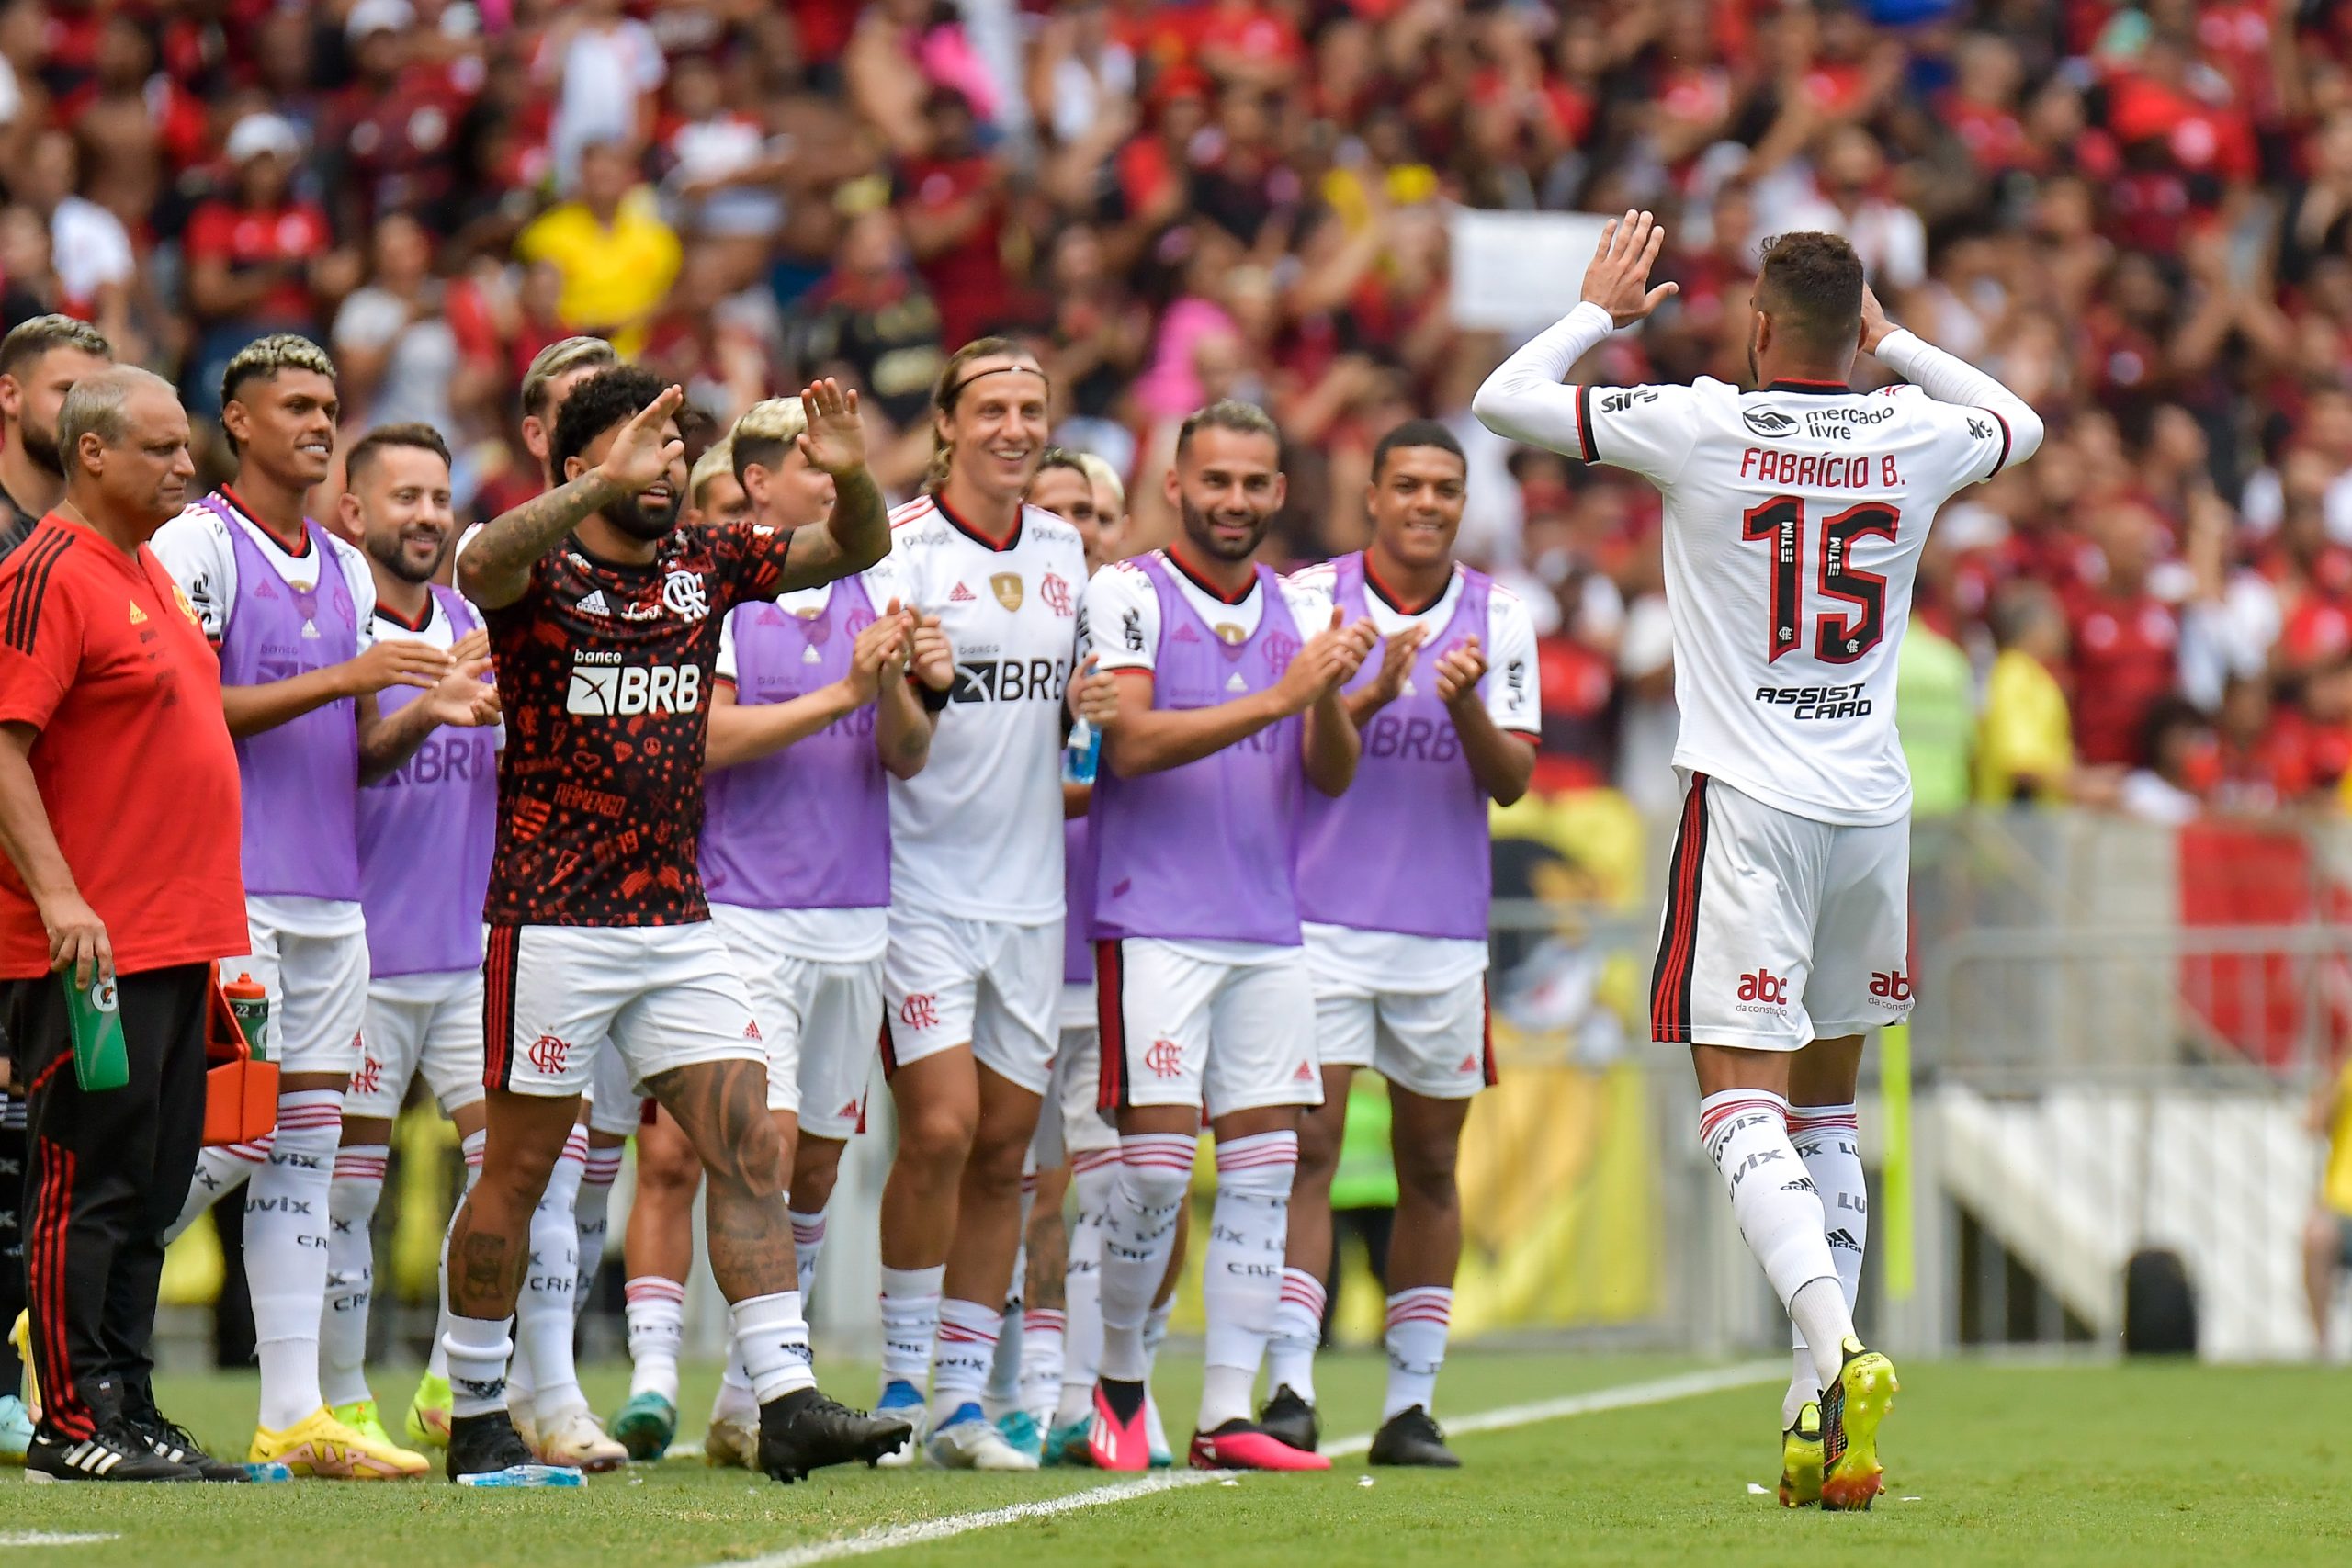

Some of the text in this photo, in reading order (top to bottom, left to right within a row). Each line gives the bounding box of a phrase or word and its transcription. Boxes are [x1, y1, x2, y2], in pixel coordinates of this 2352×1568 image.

[1806, 407, 1894, 424] mercado
[1809, 423, 1851, 440] livre
[1740, 447, 1906, 488] FABRÍCIO B.
[1742, 494, 1901, 665] 15
[574, 649, 623, 664] banco
[618, 664, 700, 716] BRB
[1755, 682, 1866, 704] ASSIST
[1794, 699, 1872, 720] CARD
[1737, 968, 1788, 1005] abc
[1869, 970, 1911, 1002] ab
